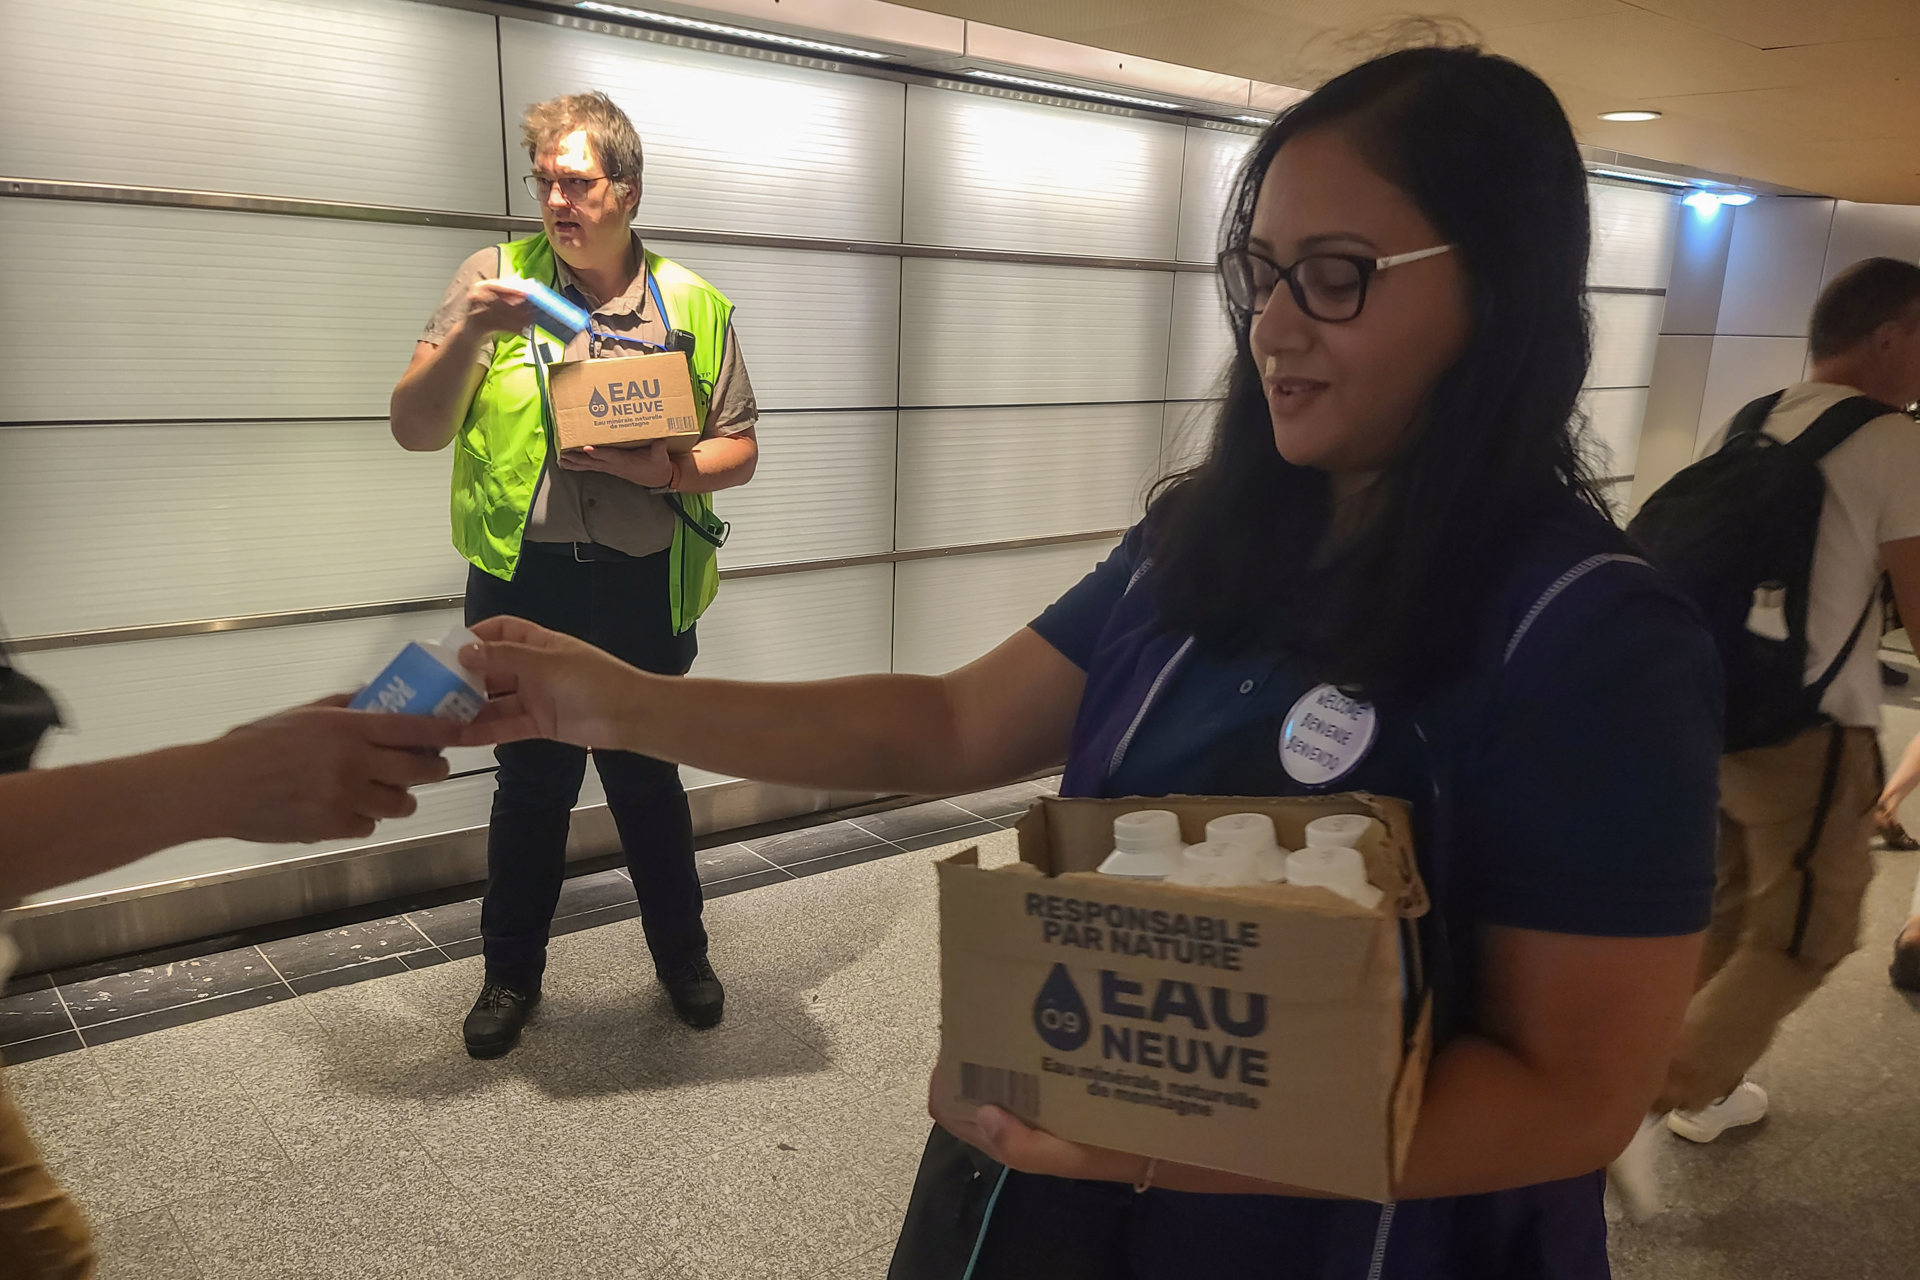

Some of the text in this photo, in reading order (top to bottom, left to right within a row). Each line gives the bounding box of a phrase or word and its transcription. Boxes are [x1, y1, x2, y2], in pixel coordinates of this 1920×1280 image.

[608, 379, 660, 402] EAU
[612, 400, 664, 416] NEUVE
[635, 414, 662, 422] naturelle
[1025, 892, 1260, 947] RESPONSABLE
[1043, 919, 1242, 971] PAR NATURE
[1100, 969, 1269, 1038] EAU
[1041, 1056, 1076, 1076] Eau
[1101, 1024, 1269, 1087] NEUVE
[1086, 1080, 1110, 1097] de
